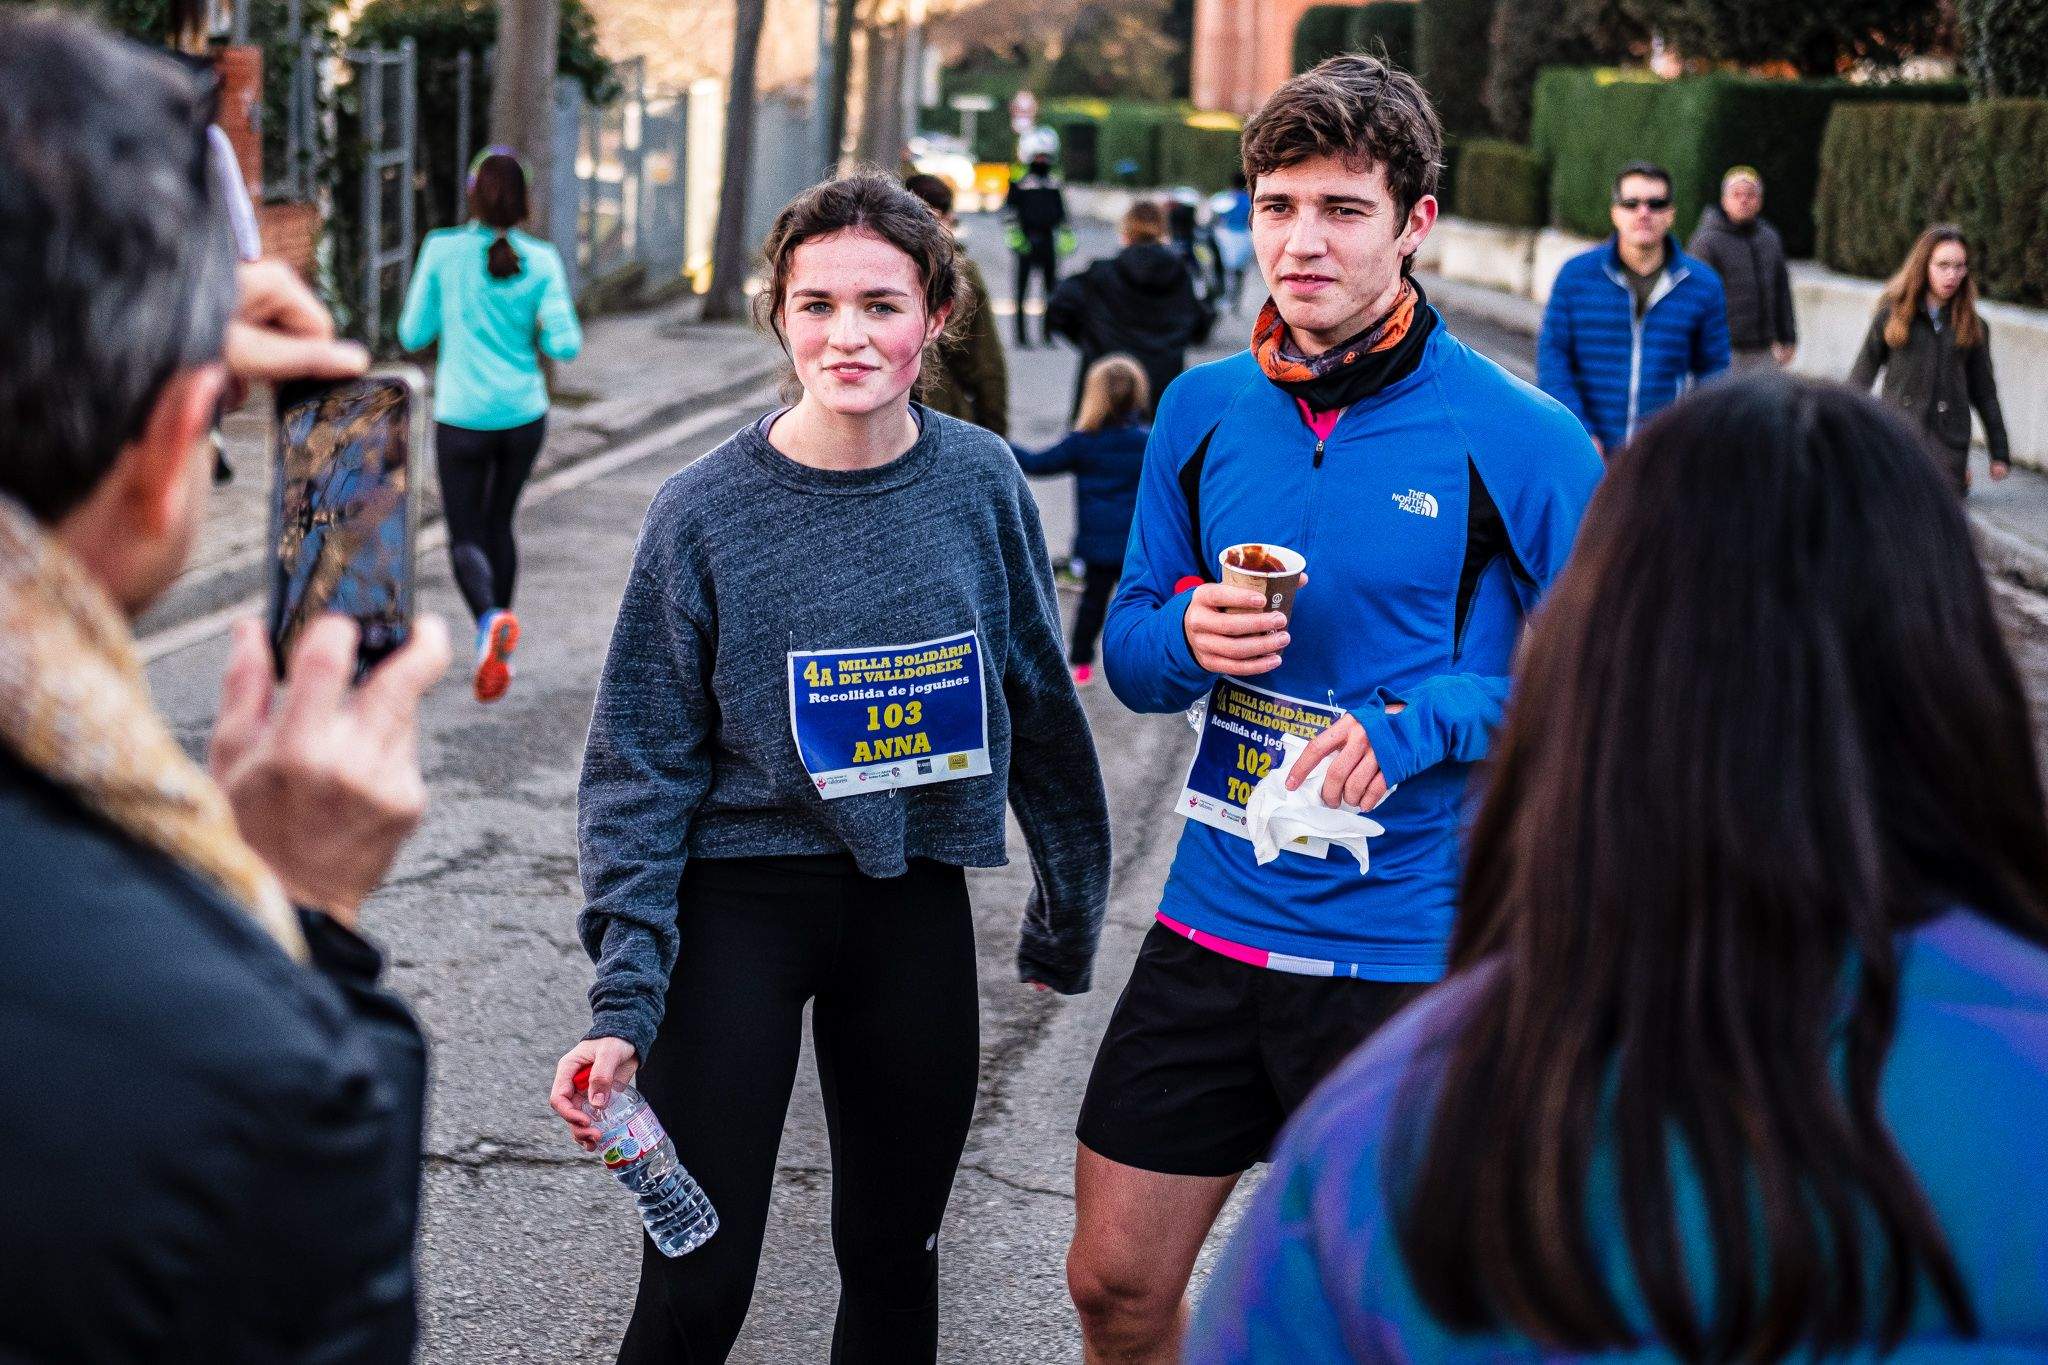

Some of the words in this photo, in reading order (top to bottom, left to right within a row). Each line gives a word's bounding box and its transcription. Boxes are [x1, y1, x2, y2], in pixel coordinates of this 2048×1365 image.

[1391, 493, 1424, 507] NORTH
[1398, 502, 1422, 515] FACE
[1408, 489, 1426, 499] THE
[838, 656, 891, 672] MILLA
[894, 643, 972, 667] SOLIDÀRIA
[838, 673, 862, 685] DE
[863, 658, 963, 683] VALLDOREIX
[808, 689, 885, 704] Recollida
[887, 685, 907, 697] de
[908, 675, 970, 697] joguines
[867, 700, 922, 731] 103
[1228, 703, 1242, 717] DE
[1240, 707, 1319, 738] VALLDOREIX
[1229, 689, 1258, 710] MILLA
[1258, 698, 1333, 728] SOLIDÀRIA
[1211, 714, 1250, 738] Recollida
[1250, 729, 1263, 742] de
[852, 732, 931, 762] ANNA
[1236, 743, 1272, 778] 102
[1227, 776, 1254, 805] TO
